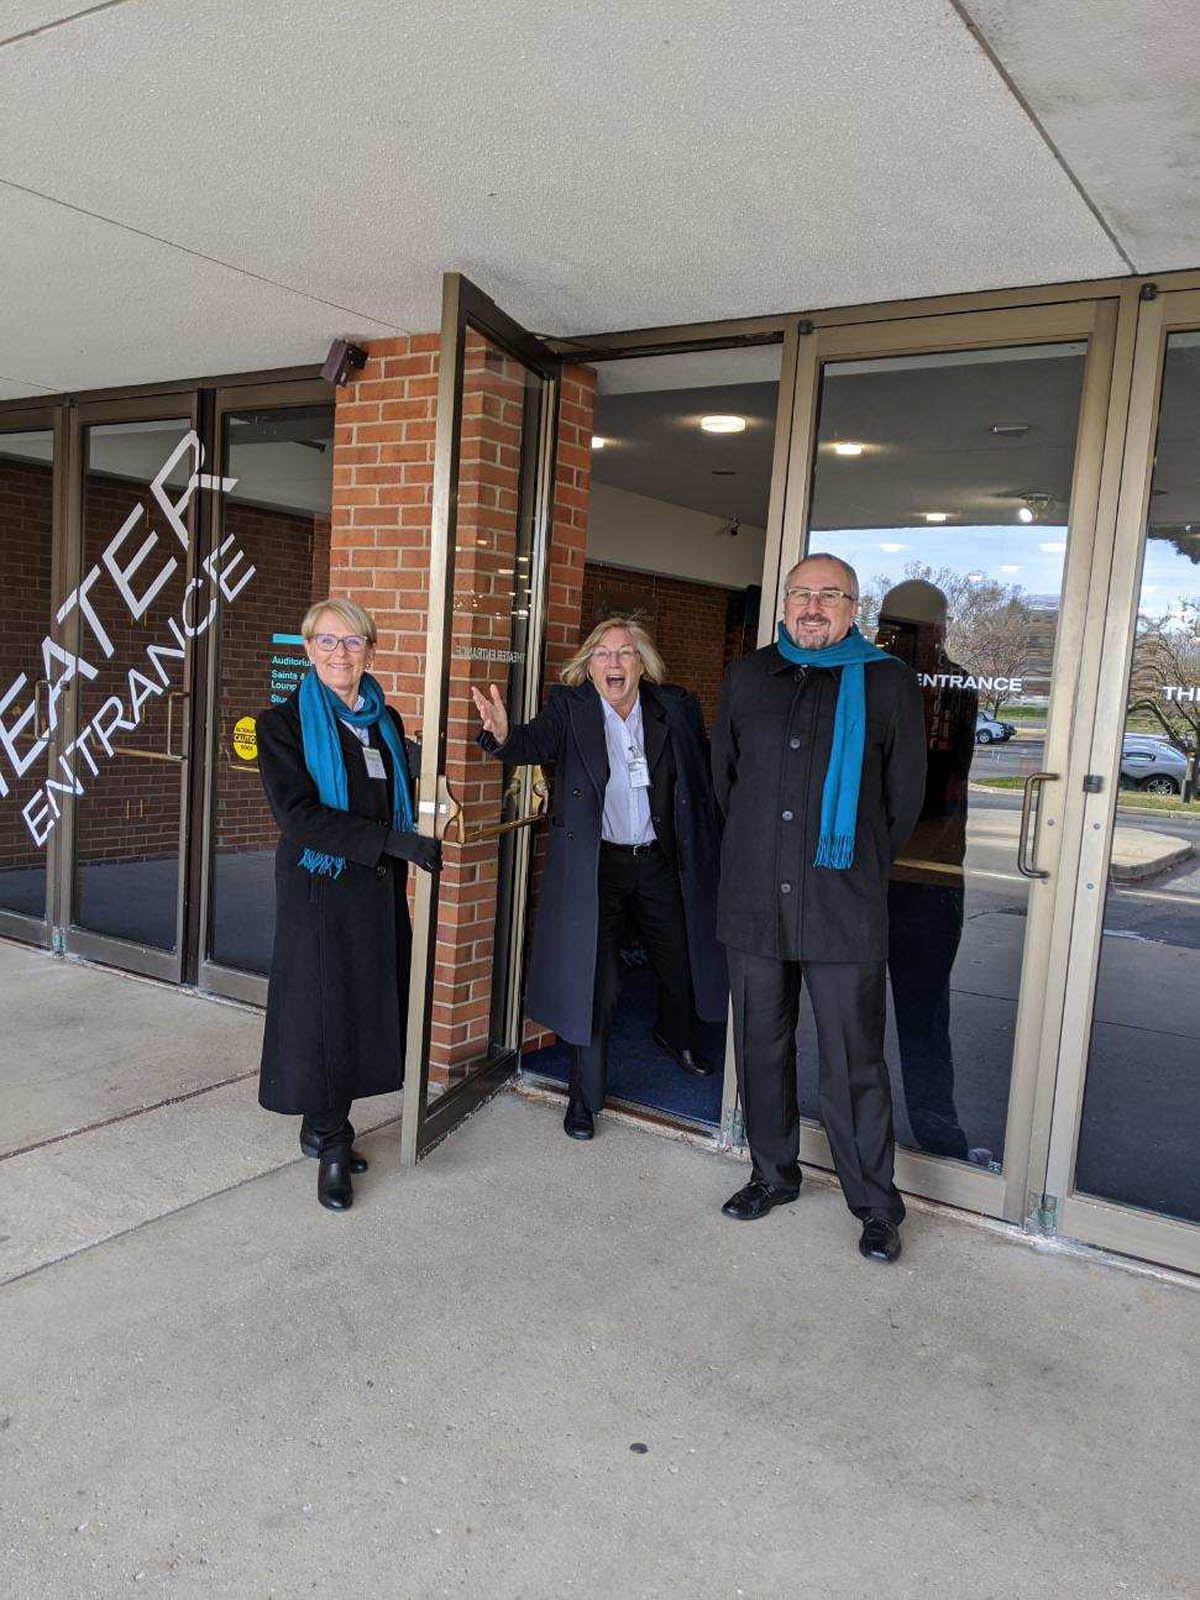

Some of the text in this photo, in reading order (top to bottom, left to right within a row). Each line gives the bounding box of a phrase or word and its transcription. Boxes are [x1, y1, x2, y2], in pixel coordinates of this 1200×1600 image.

[0, 430, 239, 798] EATER
[22, 533, 256, 847] ENTRANCE
[271, 656, 312, 667] Auditoriu
[271, 669, 298, 680] Saints
